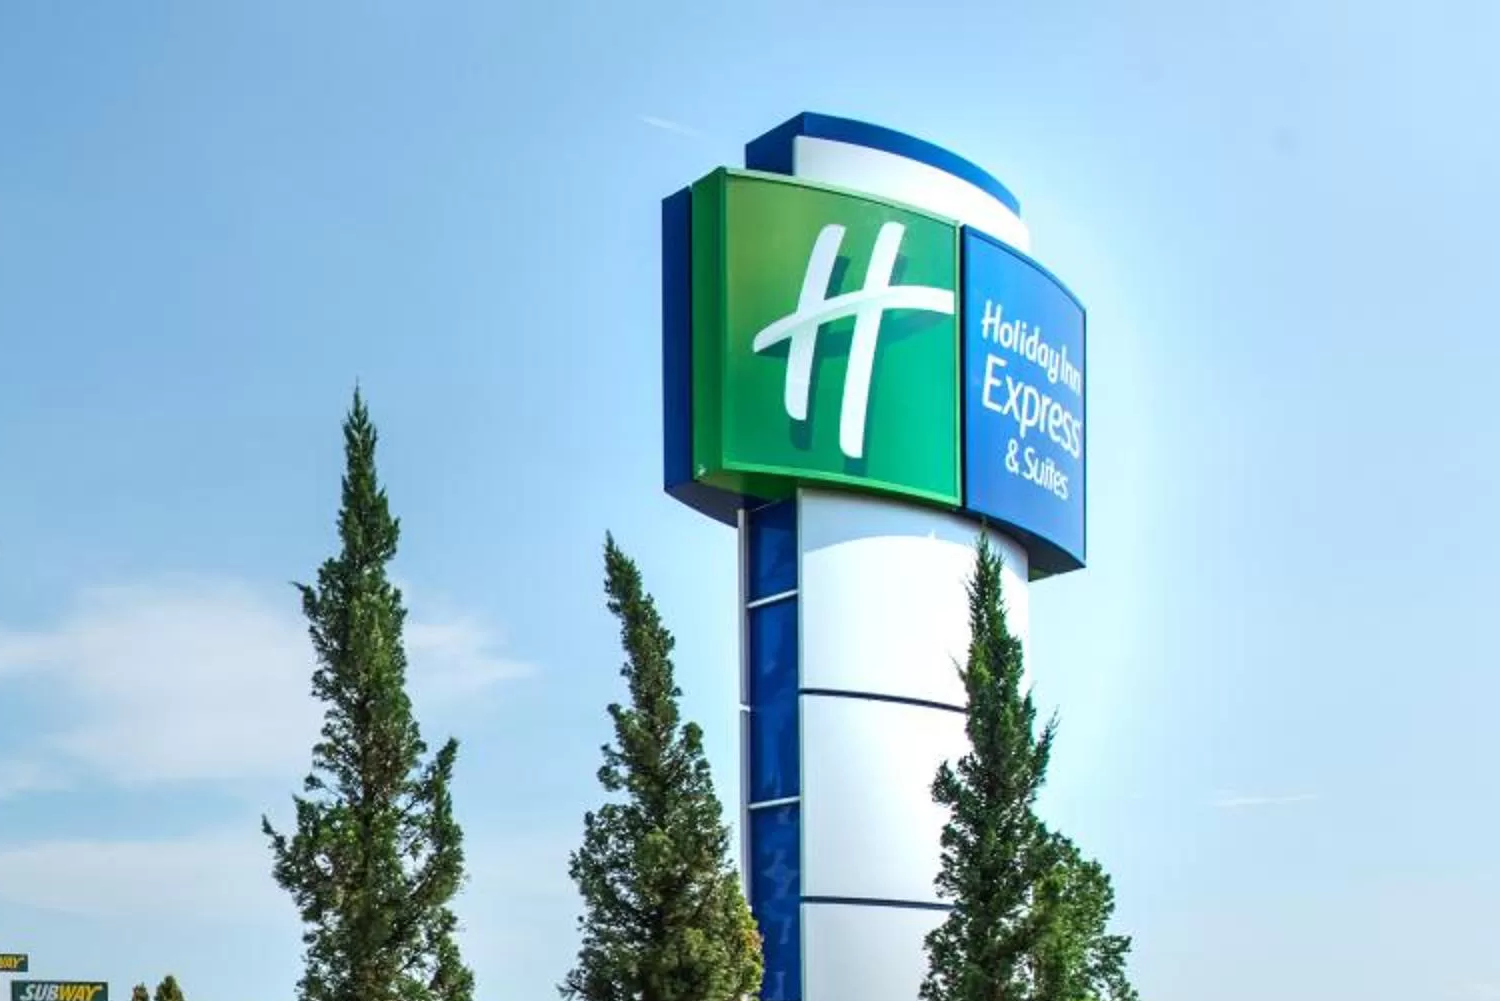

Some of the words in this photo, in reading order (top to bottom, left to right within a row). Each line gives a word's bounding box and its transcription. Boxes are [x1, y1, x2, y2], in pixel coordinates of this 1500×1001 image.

[753, 222, 955, 458] H
[982, 299, 1061, 384] Holiday
[1060, 344, 1082, 396] Inn
[982, 353, 1082, 459] Express
[1005, 438, 1019, 475] &
[1022, 447, 1070, 500] Suites
